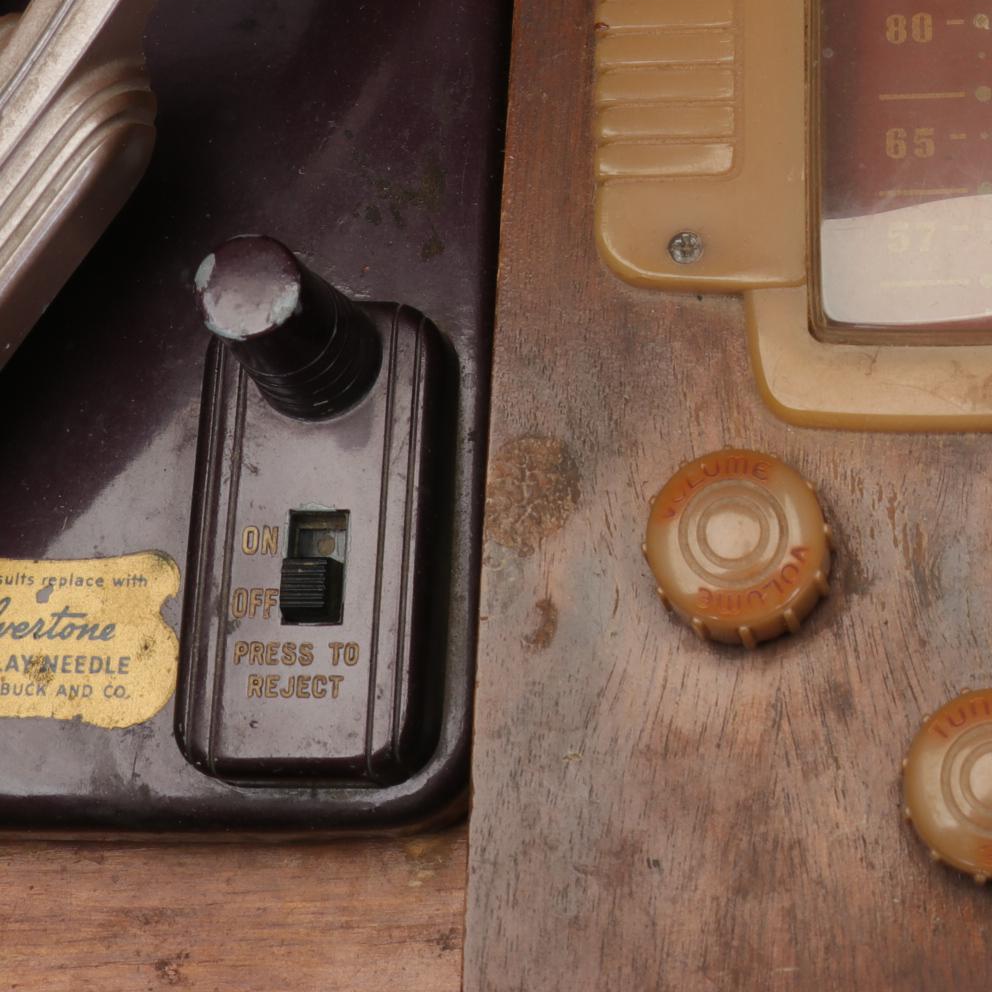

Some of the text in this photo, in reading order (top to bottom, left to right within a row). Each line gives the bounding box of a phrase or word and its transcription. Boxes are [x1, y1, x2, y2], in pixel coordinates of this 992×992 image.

[885, 12, 934, 44] 80
[885, 127, 935, 159] 65
[887, 220, 936, 253] 57
[241, 525, 279, 555] ON
[42, 572, 104, 591] replace
[113, 574, 148, 587] with
[697, 546, 809, 614] VOLUME
[231, 587, 279, 619] OFF
[43, 654, 131, 675] NEEDLE
[233, 640, 360, 666] PRESS TO
[56, 684, 93, 698] AND
[247, 674, 345, 698] REJECT
